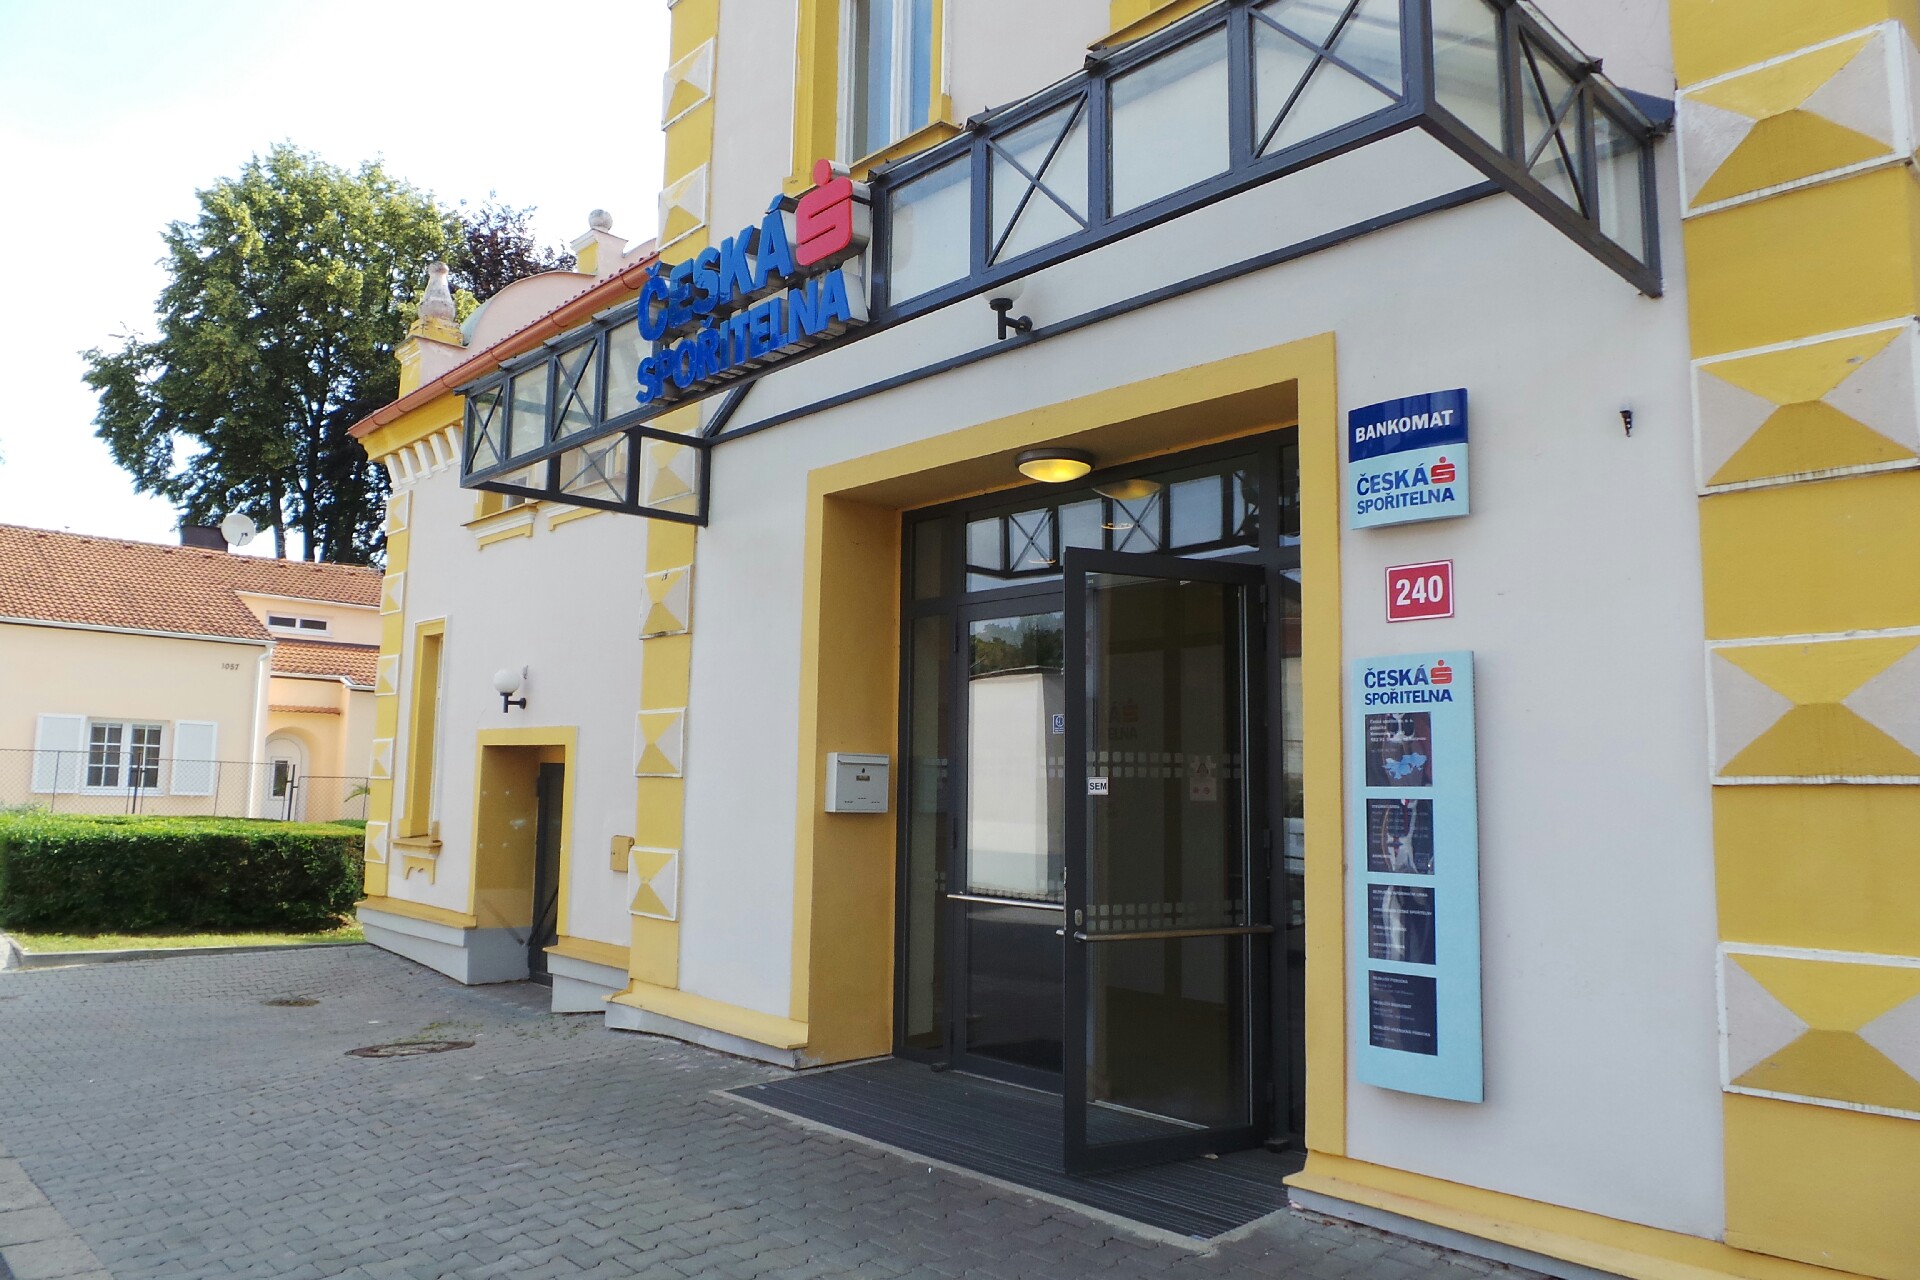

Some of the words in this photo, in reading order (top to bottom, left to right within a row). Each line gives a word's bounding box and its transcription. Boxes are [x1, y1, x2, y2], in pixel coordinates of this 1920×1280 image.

[637, 192, 795, 341] ČESKÁ
[636, 269, 851, 403] SPOŘITELNA
[1355, 409, 1454, 443] BANKOMAT
[1356, 463, 1429, 496] ČESKÁ
[1357, 487, 1455, 515] SPOŘITELNA
[1395, 575, 1444, 606] 240
[221, 662, 240, 671] 1057
[1364, 664, 1429, 689] ČESKÁ
[1364, 688, 1453, 706] SPOŘITELNA
[1089, 782, 1107, 791] SEM
